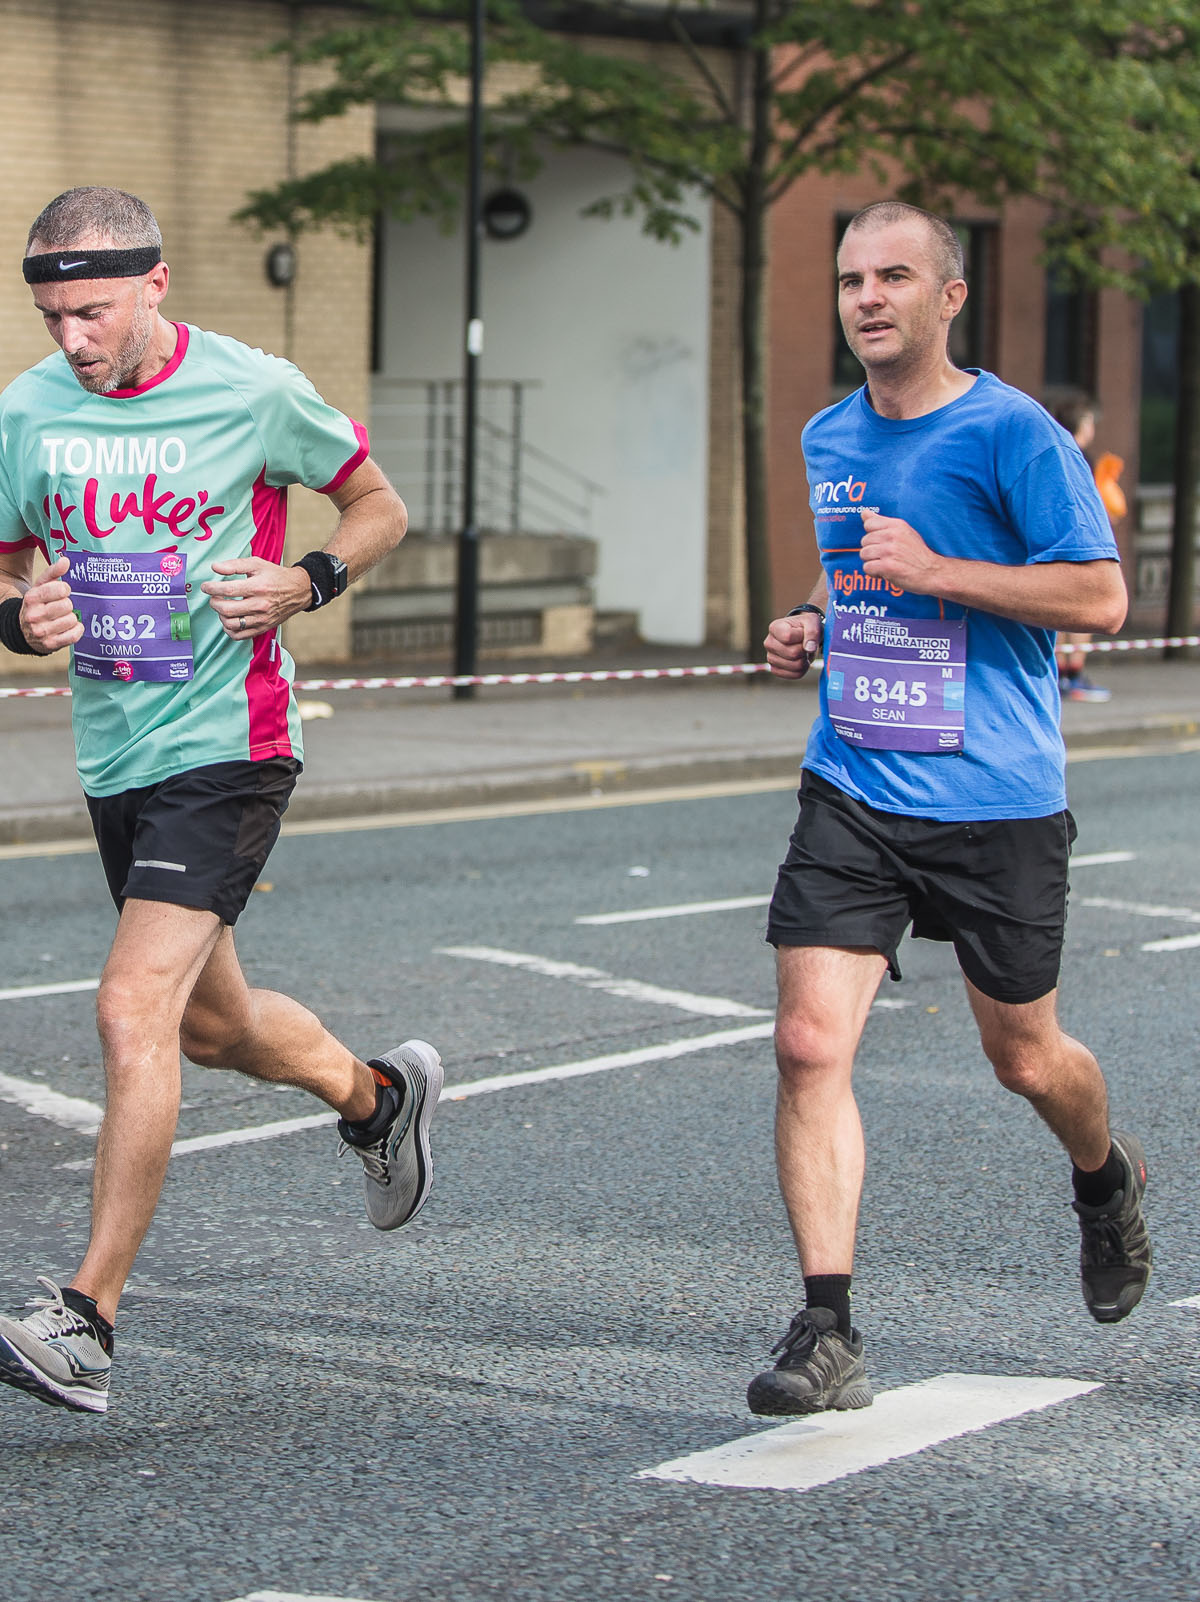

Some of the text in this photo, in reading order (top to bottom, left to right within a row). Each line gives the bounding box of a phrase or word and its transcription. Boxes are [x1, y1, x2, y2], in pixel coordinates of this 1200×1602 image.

[42, 436, 187, 475] TOMMO
[83, 473, 226, 542] Luke's
[87, 563, 130, 572] SHEFFIELD
[88, 573, 170, 583] HALF MARATHON
[142, 583, 170, 594] 2020
[167, 600, 176, 610] L
[90, 614, 156, 641] 6832
[864, 624, 907, 636] SHEFFIELD
[863, 634, 949, 649] HALF MARATHON
[99, 643, 142, 656] TOMMO
[918, 649, 950, 660] 2020
[941, 668, 953, 679] M
[854, 675, 928, 707] 8345
[871, 707, 905, 721] SEAN
